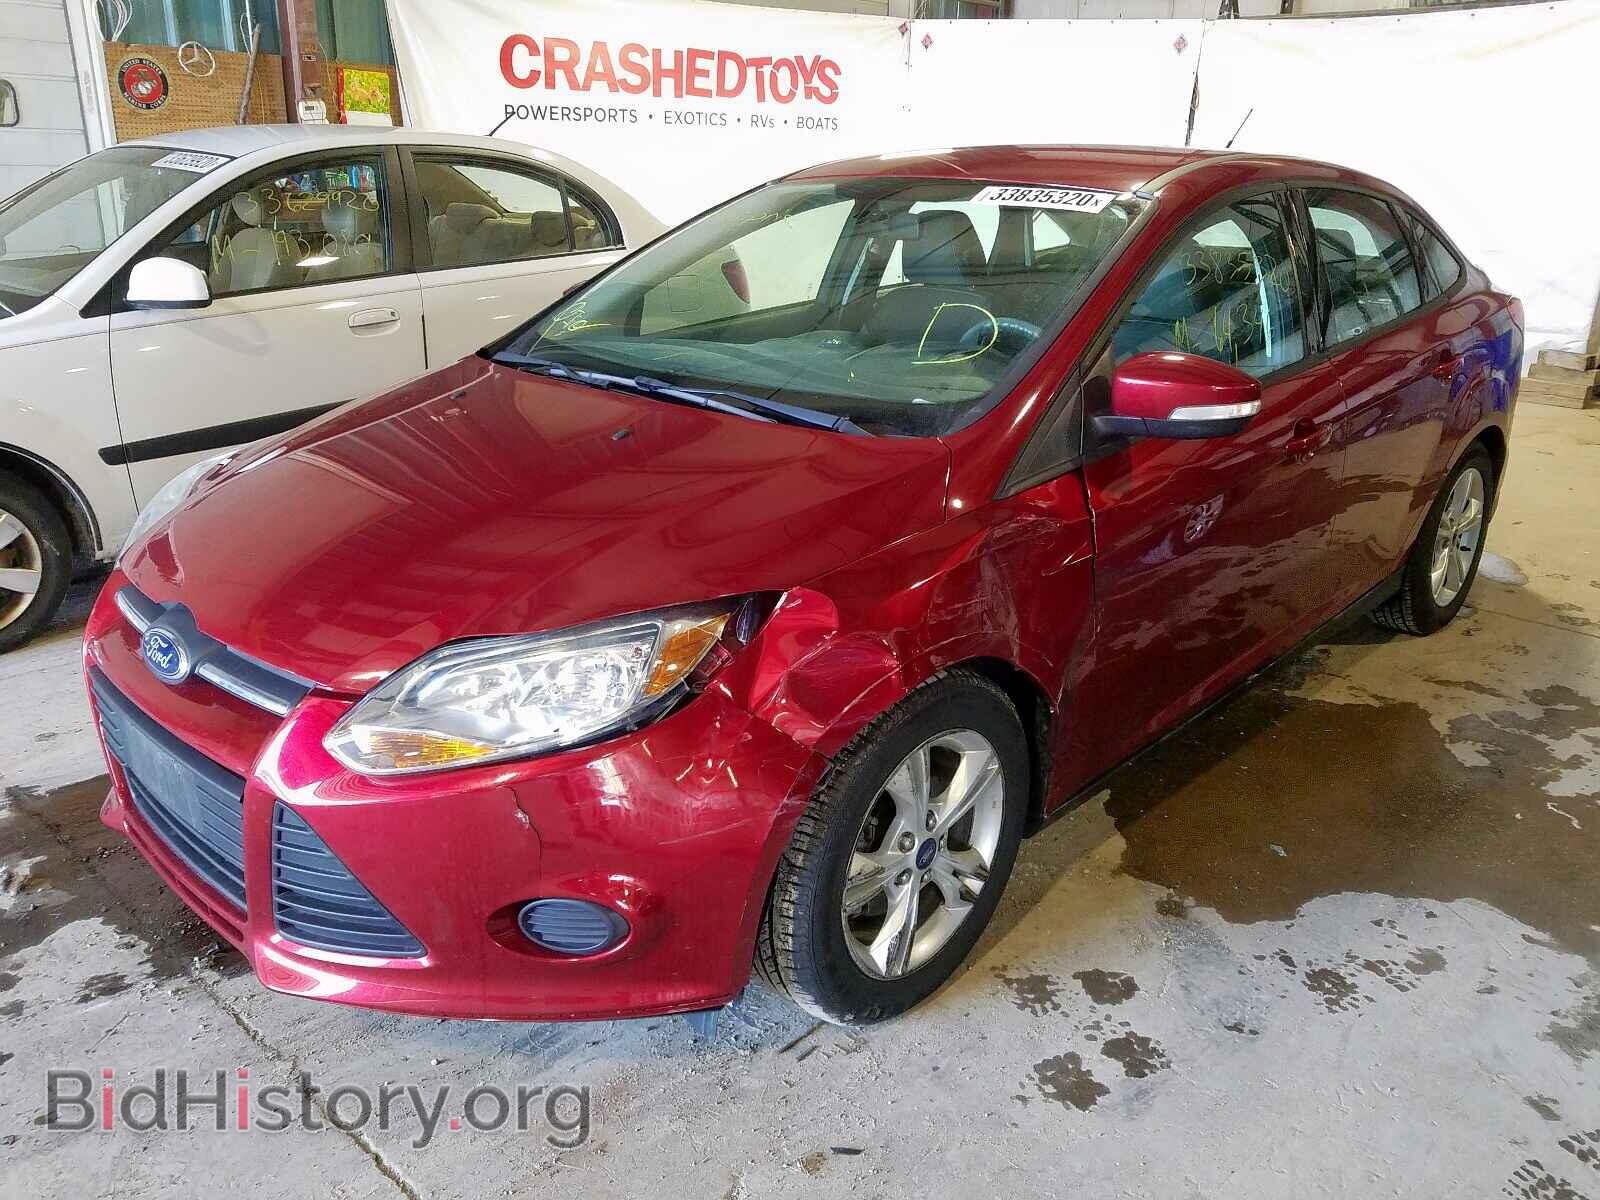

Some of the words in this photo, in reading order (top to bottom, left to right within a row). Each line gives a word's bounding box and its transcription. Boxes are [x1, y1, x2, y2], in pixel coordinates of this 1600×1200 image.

[499, 32, 842, 105] CRASHEDTOYS
[504, 103, 638, 124] POWERSPORTS
[664, 110, 728, 128] EXOTICS
[750, 115, 776, 129] RVs
[796, 116, 839, 131] BOATS
[145, 635, 172, 669] Ford
